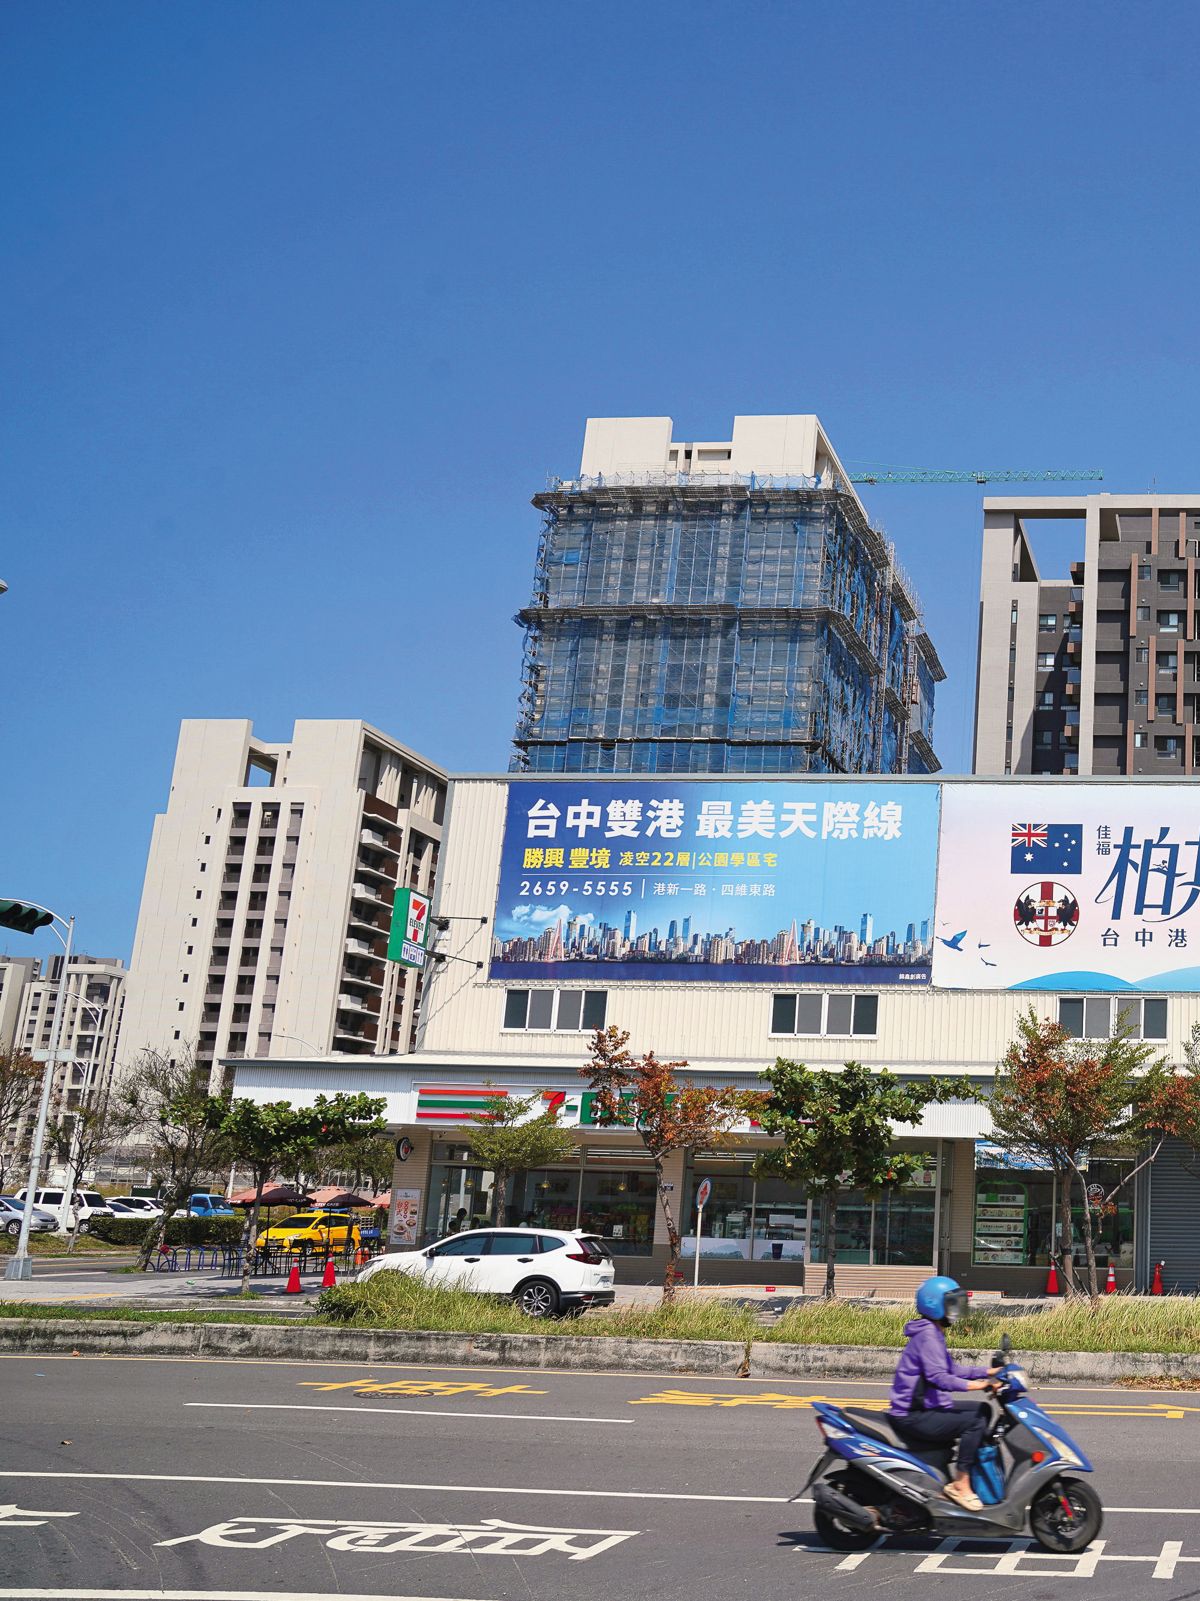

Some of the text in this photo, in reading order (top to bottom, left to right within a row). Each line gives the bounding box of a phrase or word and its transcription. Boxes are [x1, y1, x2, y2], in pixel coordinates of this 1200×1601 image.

[526, 799, 903, 841] 台中雙港 最美天際線
[1095, 824, 1112, 856] 佳福
[522, 847, 564, 869] 勝興
[568, 847, 611, 869] 豐境
[519, 880, 633, 897] 2659-5555
